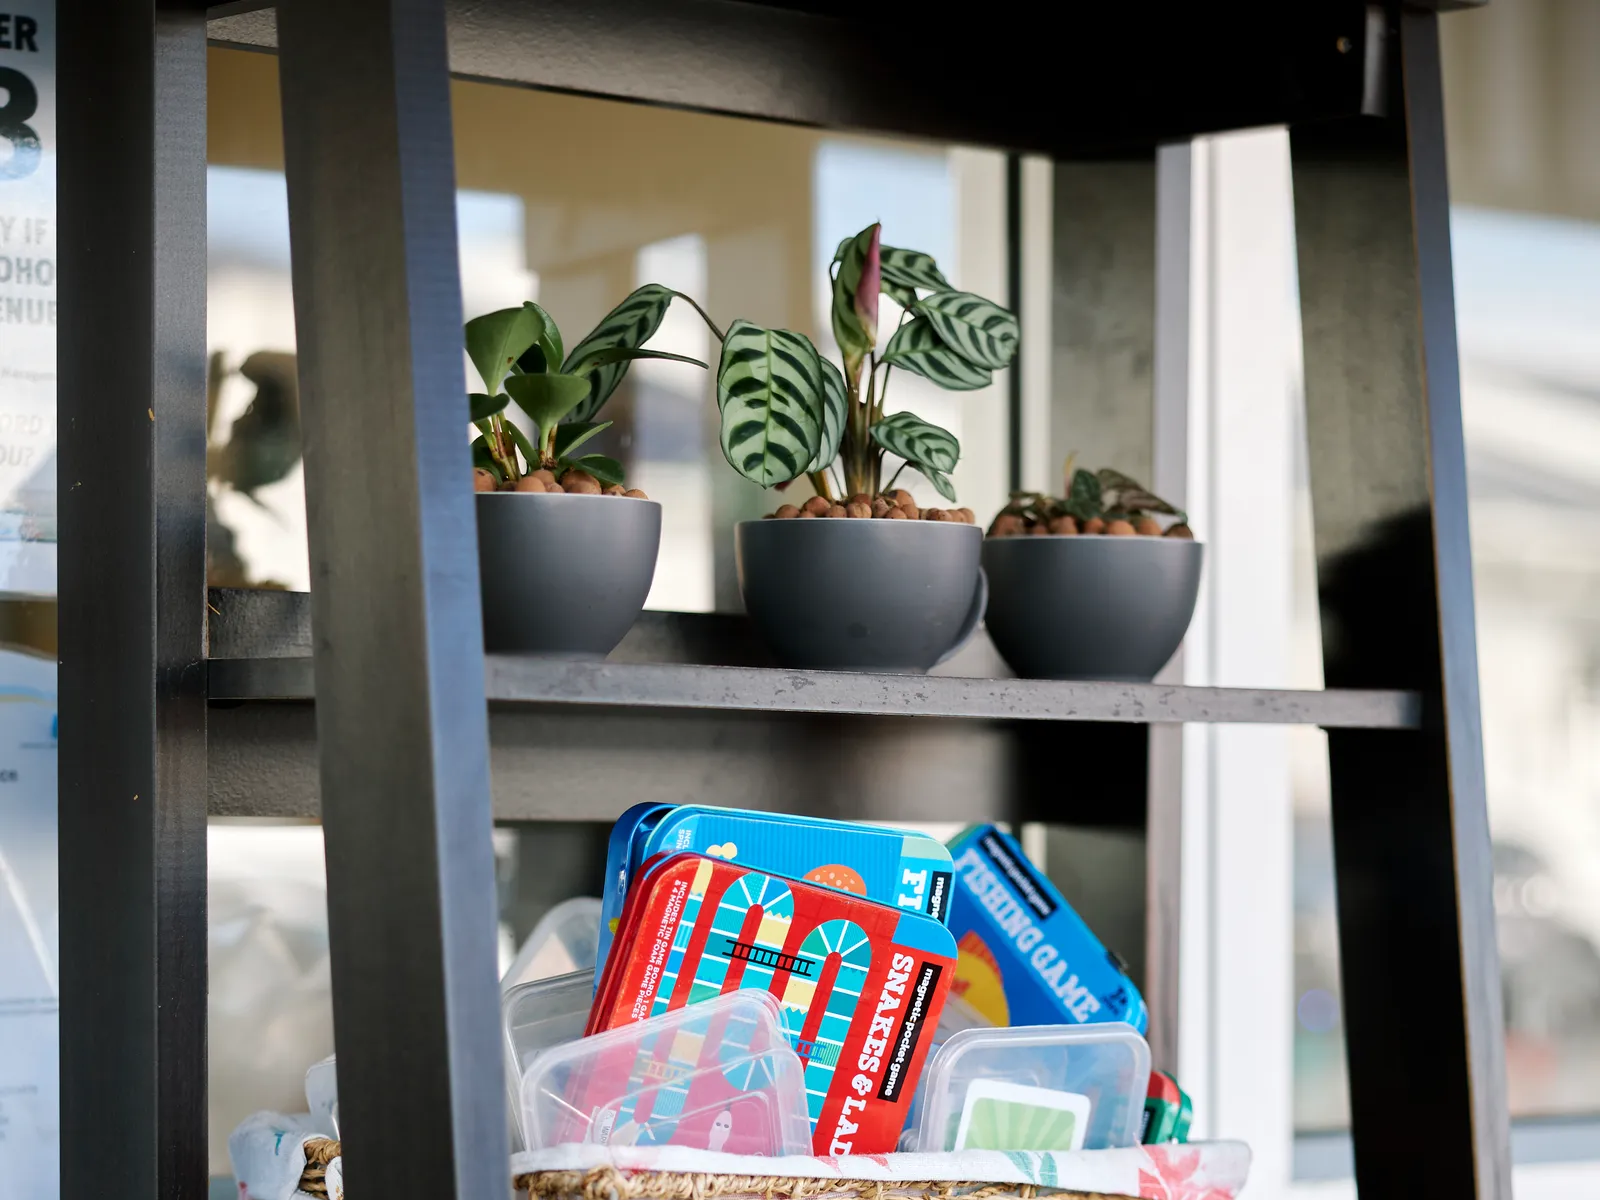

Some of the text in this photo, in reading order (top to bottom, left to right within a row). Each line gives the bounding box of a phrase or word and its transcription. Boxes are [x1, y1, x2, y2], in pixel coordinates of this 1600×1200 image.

[24, 216, 48, 245] IF
[676, 829, 685, 849] SPIN
[669, 881, 688, 925] INCLUDES:
[898, 868, 927, 910] FI
[657, 895, 676, 938] MAGNETIC
[663, 926, 674, 940] TIN
[955, 848, 1100, 1023] FISHING GAME
[649, 938, 662, 964] FOAM
[655, 941, 668, 965] GAME
[640, 965, 653, 989] GAME
[631, 990, 645, 1019] PIECES
[884, 968, 934, 1096] magnetic pocket game
[829, 952, 915, 1157] SNAKES & LAD
